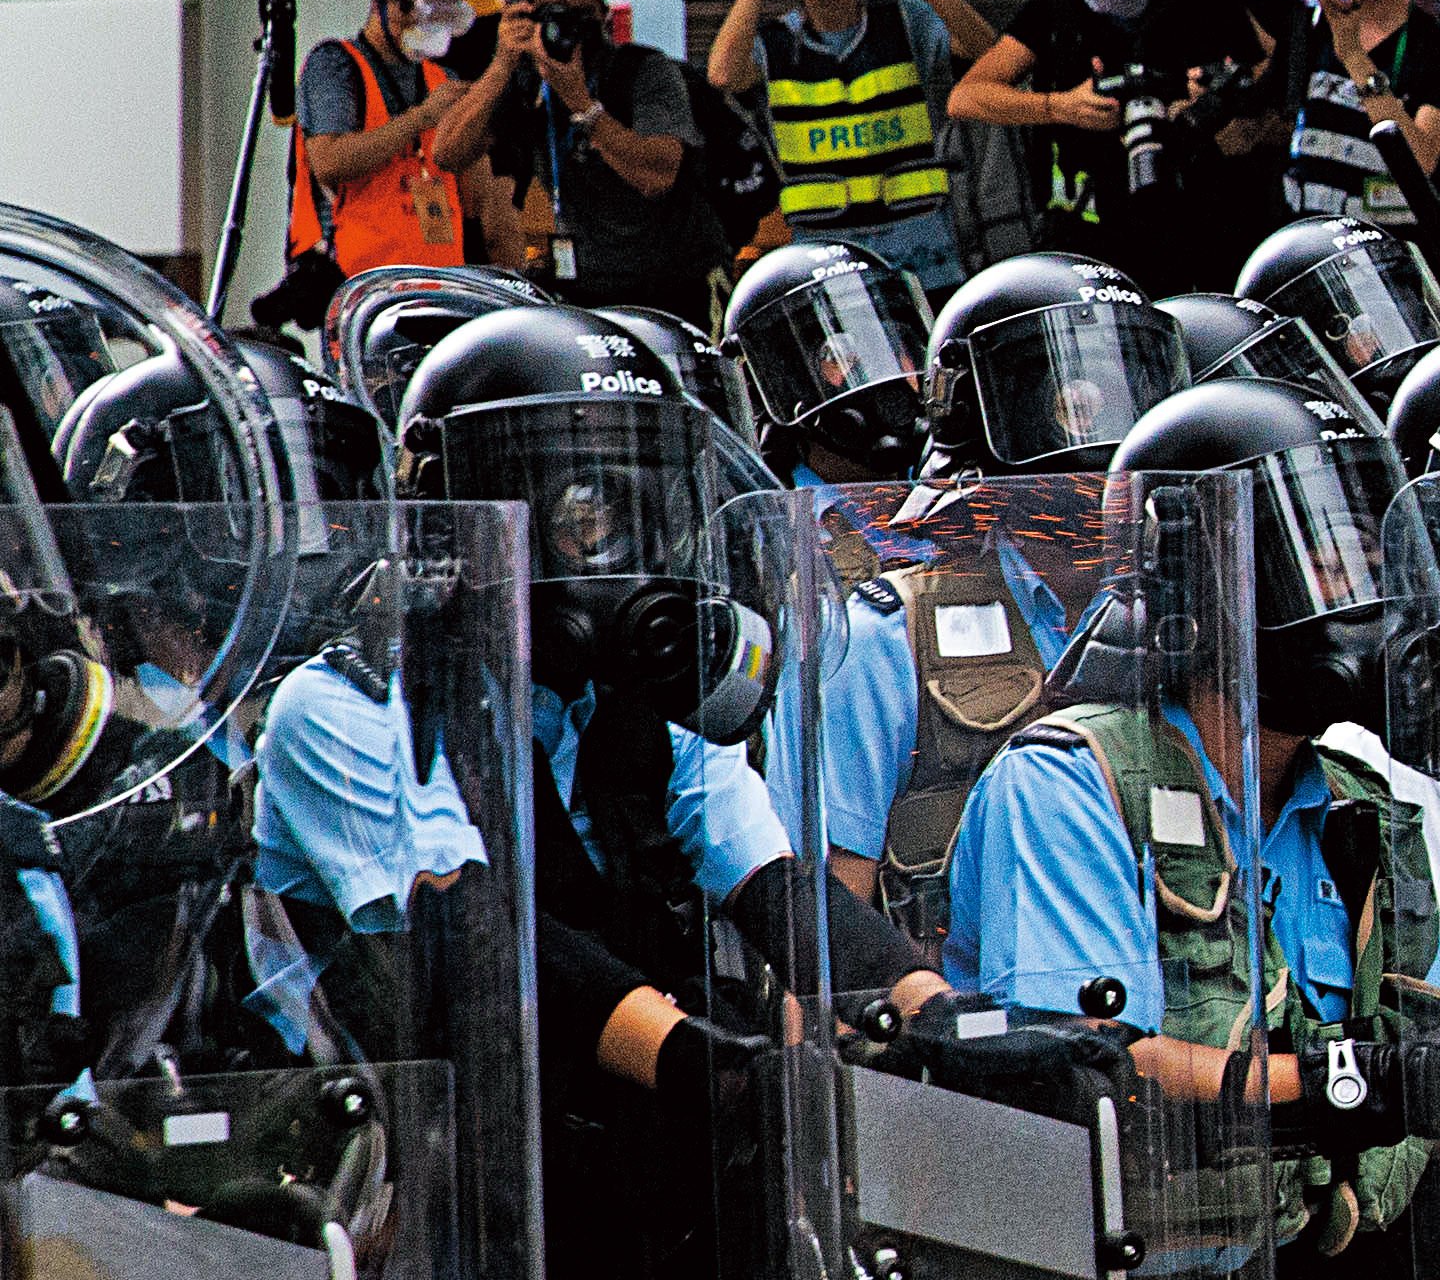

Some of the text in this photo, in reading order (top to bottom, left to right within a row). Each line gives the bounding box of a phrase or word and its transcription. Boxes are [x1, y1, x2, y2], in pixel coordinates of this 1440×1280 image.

[809, 116, 905, 153] PRESS
[1332, 229, 1383, 250] Police
[1078, 285, 1142, 305] Police
[575, 334, 637, 358] 警察
[581, 370, 663, 396] Police
